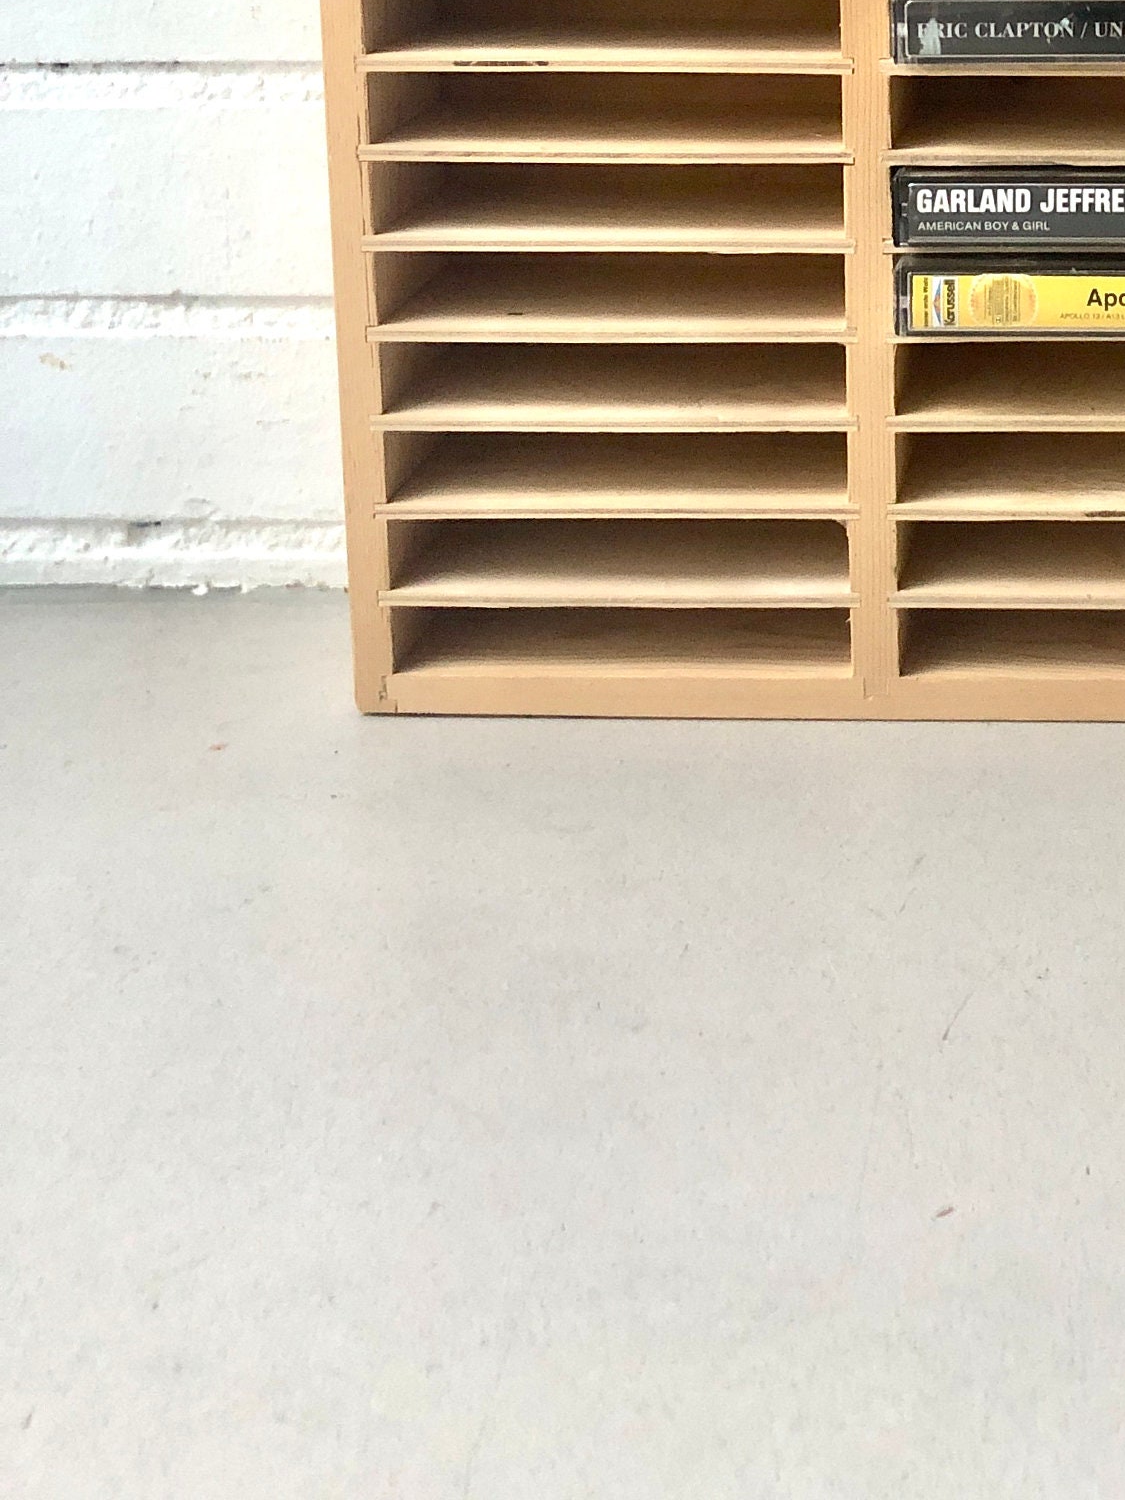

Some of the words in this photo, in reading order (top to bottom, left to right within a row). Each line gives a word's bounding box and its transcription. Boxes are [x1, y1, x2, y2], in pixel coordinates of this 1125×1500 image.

[974, 22, 1074, 38] CLAPTON
[1080, 22, 1087, 38] /
[916, 188, 1031, 213] GARLAND
[918, 221, 981, 231] AMERICAN
[984, 221, 1009, 231] BOY
[1012, 221, 1020, 230] &
[1023, 221, 1050, 231] GIRL
[943, 279, 955, 325] Karussell
